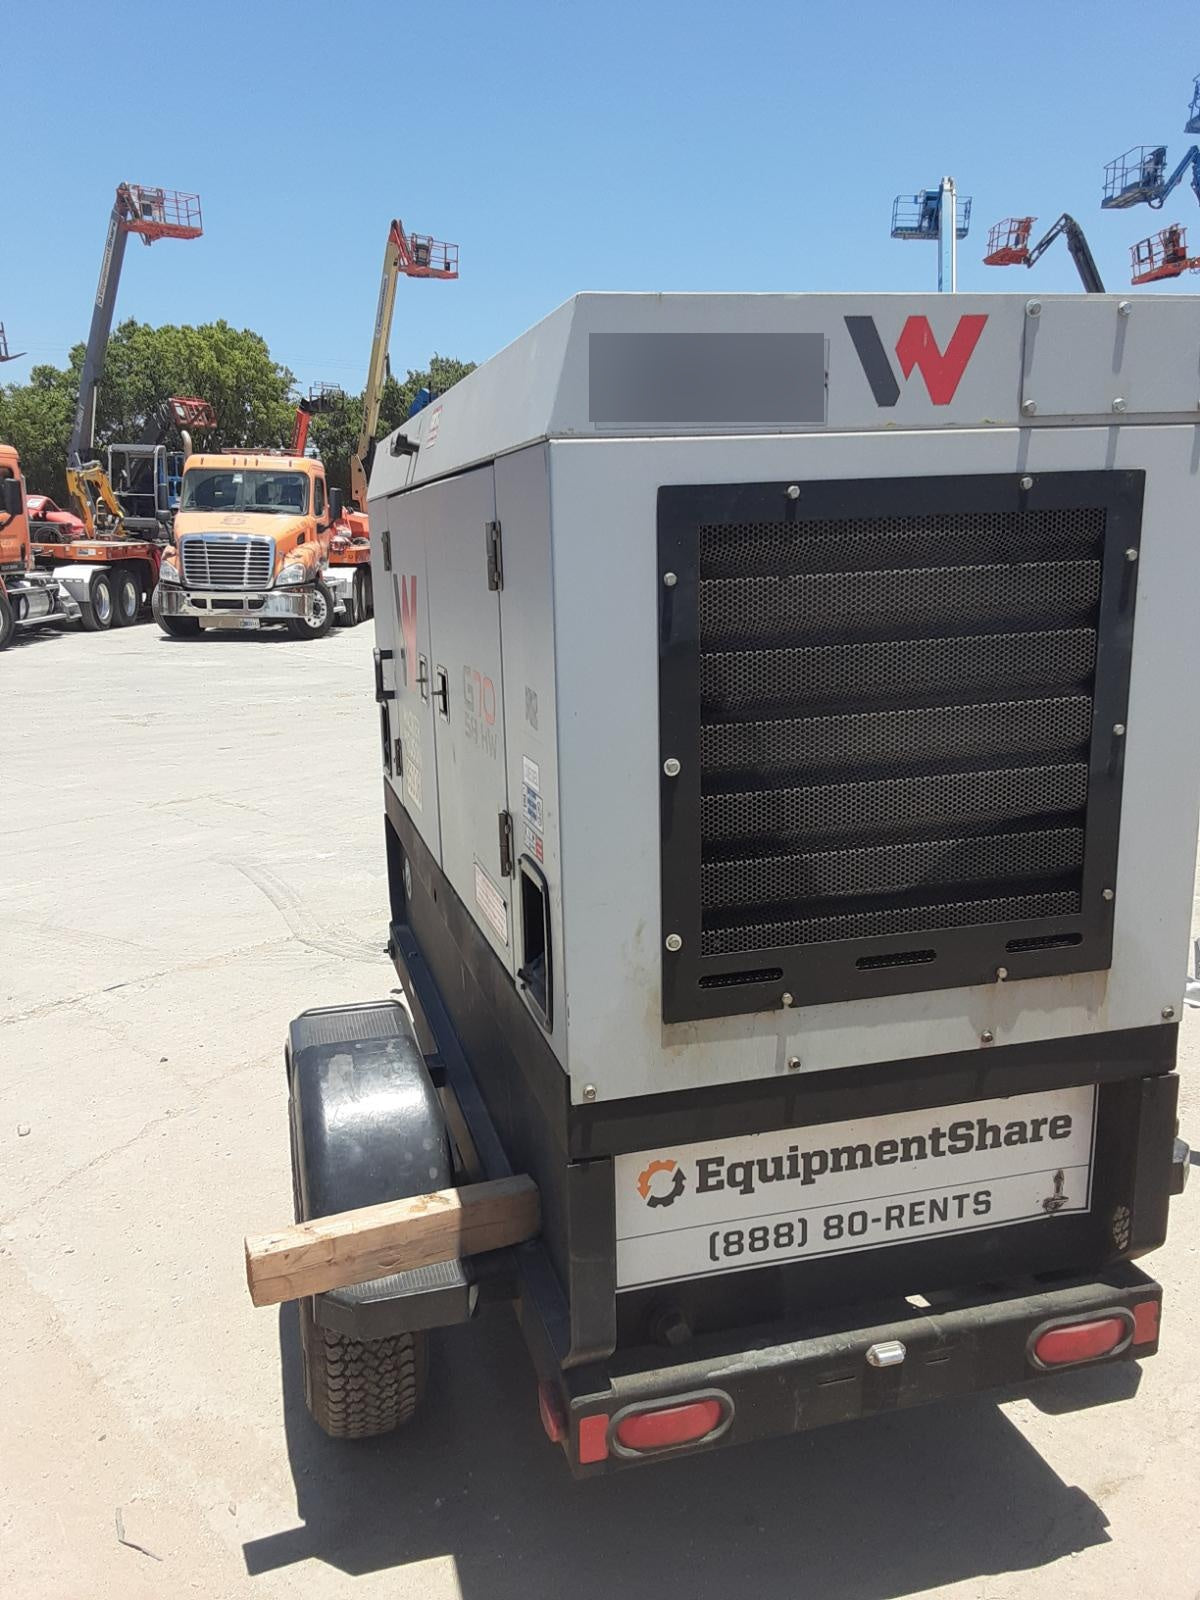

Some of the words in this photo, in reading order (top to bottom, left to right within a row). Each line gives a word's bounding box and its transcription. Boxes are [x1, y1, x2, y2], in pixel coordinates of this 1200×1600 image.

[463, 665, 496, 725] G70
[695, 1114, 1073, 1195] EquipmentShare
[709, 1218, 808, 1261] (888)
[823, 1190, 992, 1240] 80-RENTS
